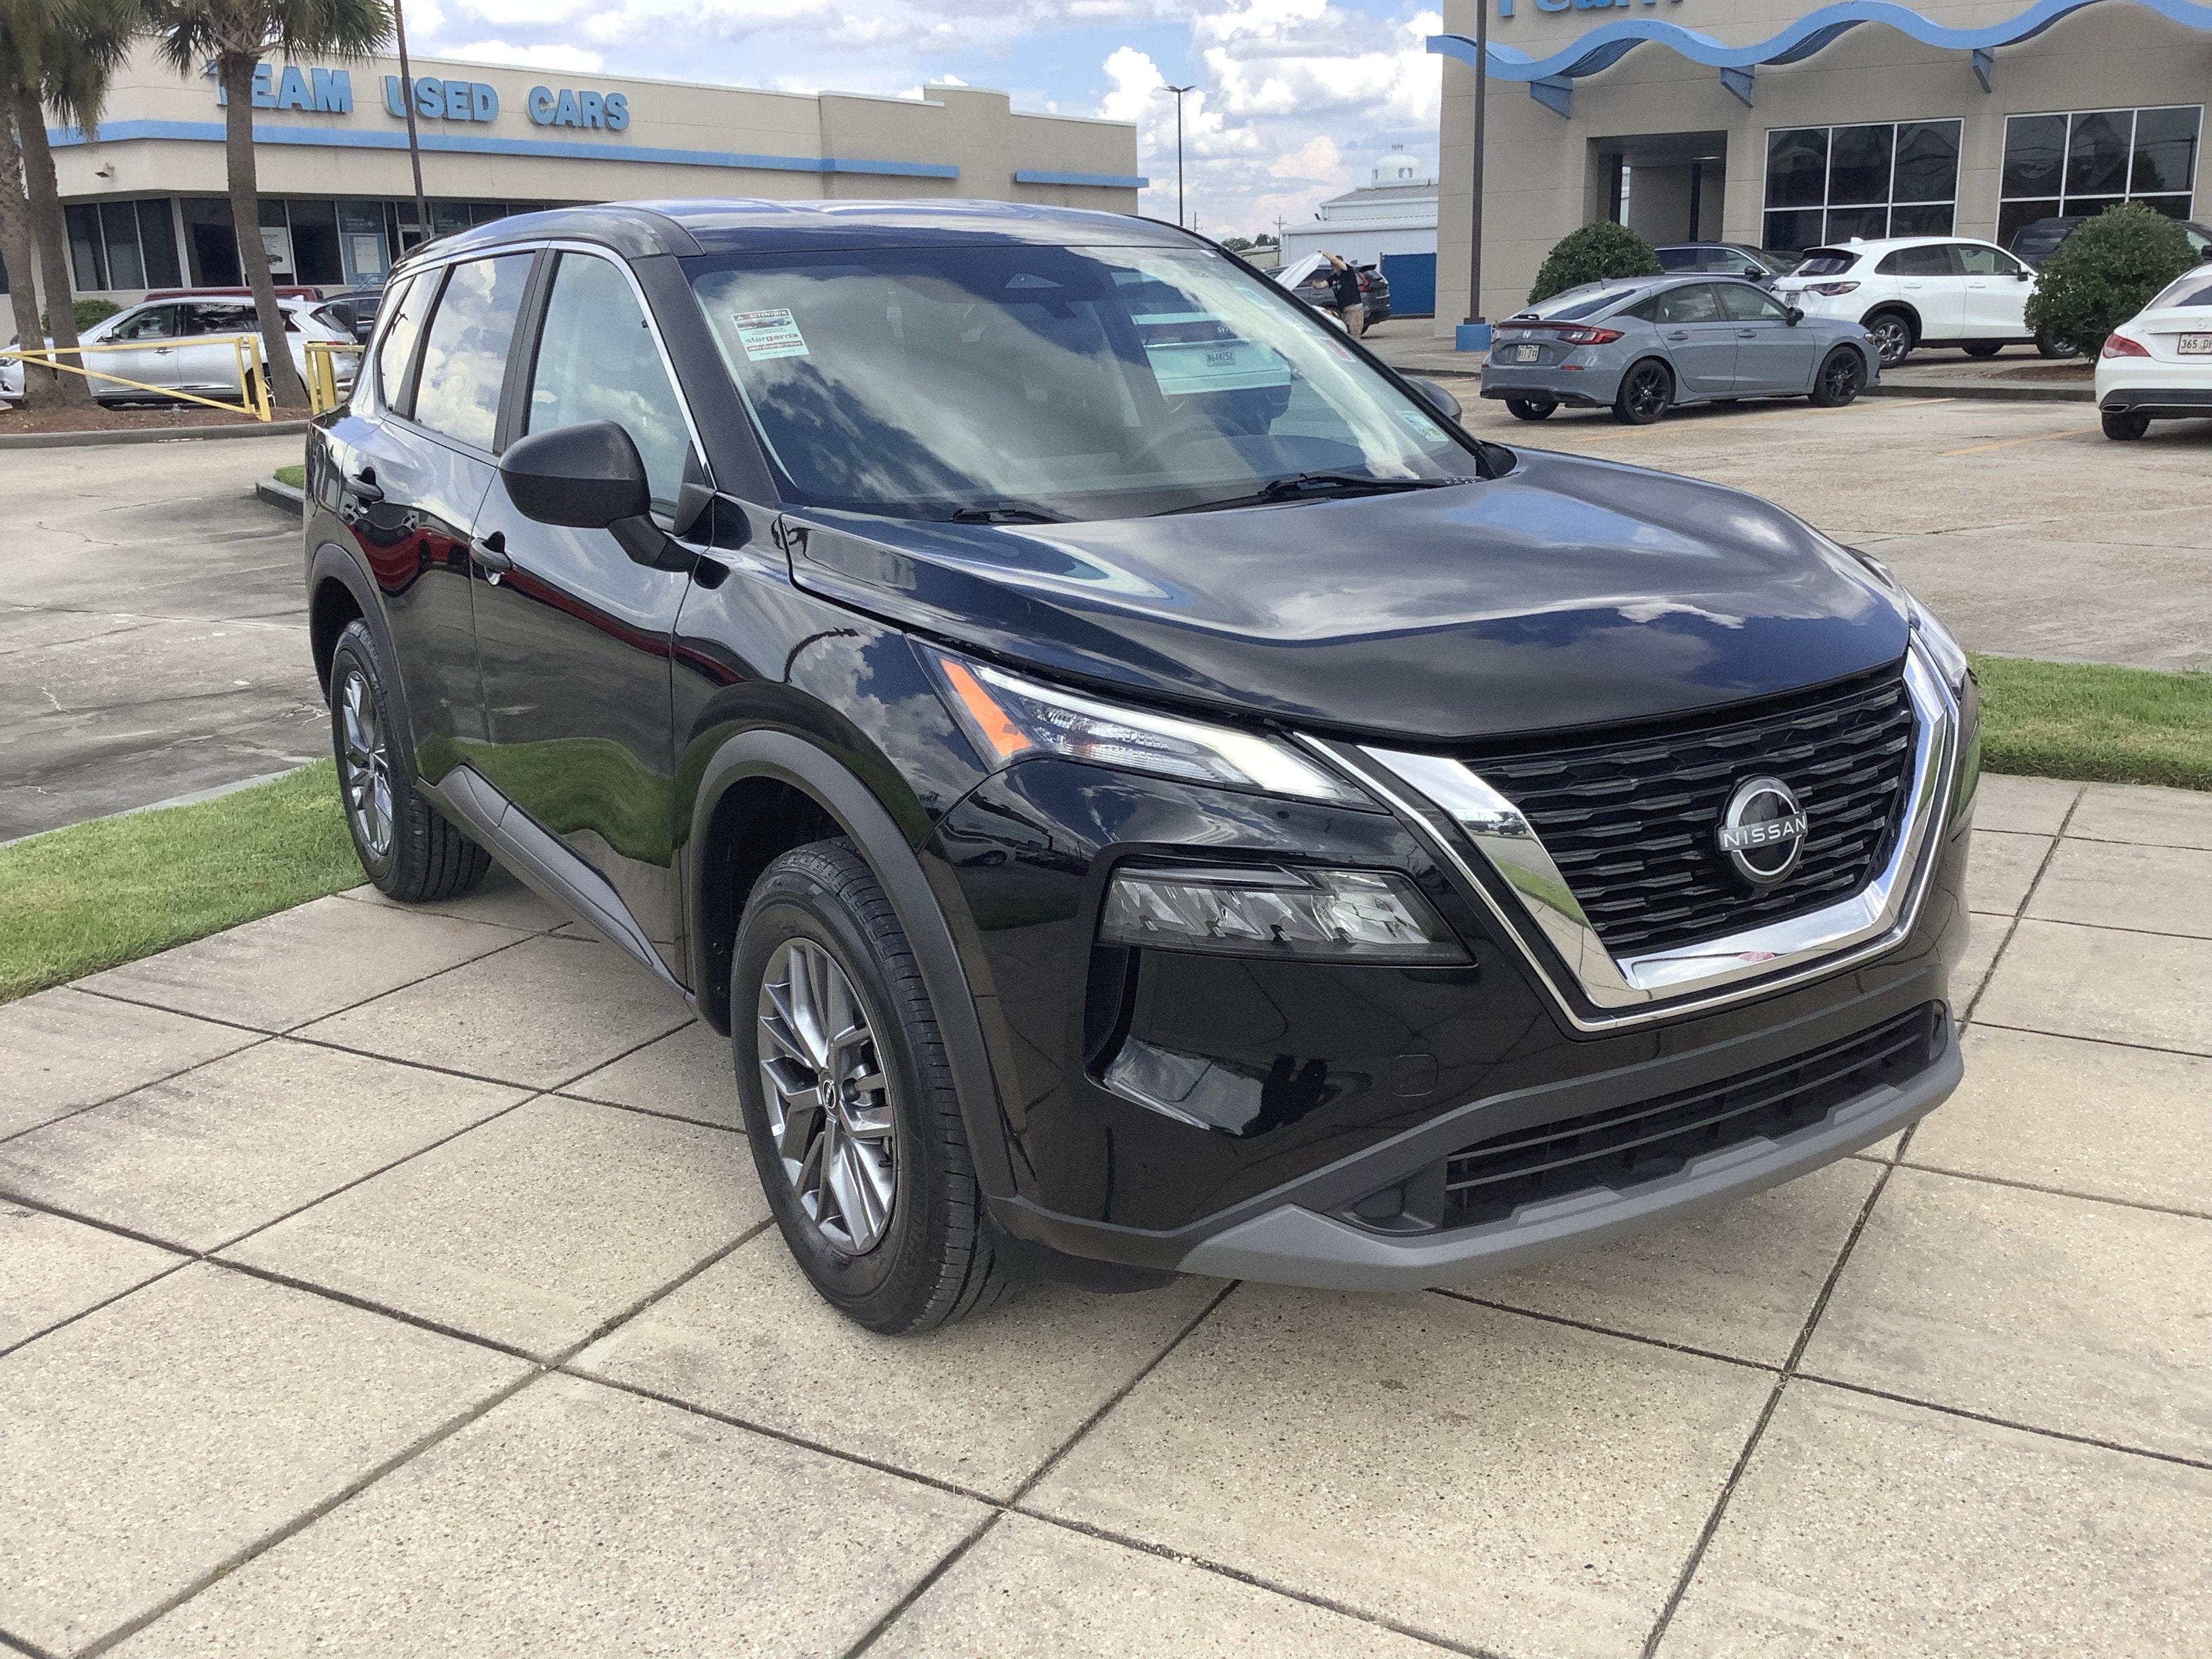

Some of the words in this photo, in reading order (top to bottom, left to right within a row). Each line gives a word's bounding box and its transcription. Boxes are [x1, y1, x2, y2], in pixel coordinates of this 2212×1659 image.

[381, 75, 499, 122] USED
[527, 85, 630, 131] CARS
[2181, 340, 2198, 349] 365
[1723, 815, 1806, 847] NISSAN
